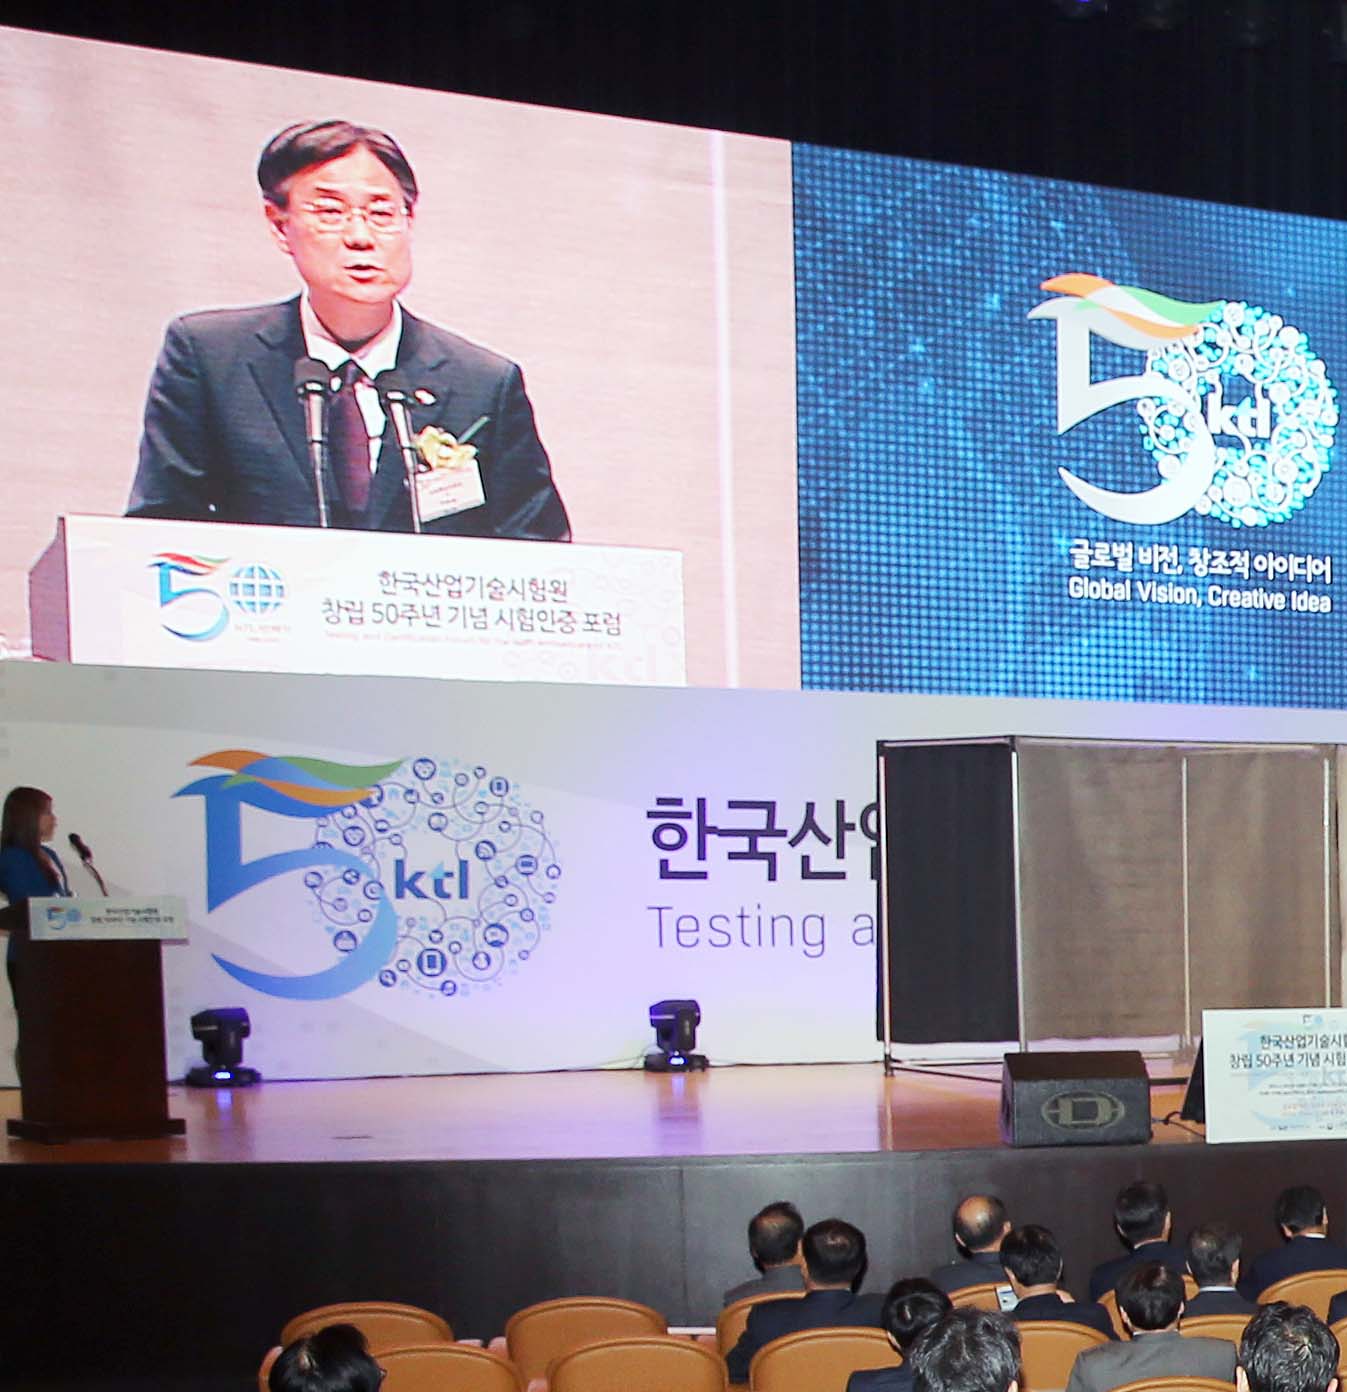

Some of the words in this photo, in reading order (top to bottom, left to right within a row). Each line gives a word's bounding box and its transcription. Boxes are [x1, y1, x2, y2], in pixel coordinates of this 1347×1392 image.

[1069, 538, 1134, 572] 글로벌
[1188, 547, 1250, 580] 창조적
[1253, 552, 1332, 585] 아이디어
[378, 569, 568, 604] 한국산업기술시험원
[1068, 576, 1132, 601] Global
[1136, 579, 1202, 608] Vision,
[1207, 585, 1286, 611] Creative
[1291, 590, 1332, 613] Idea
[322, 597, 365, 626] 창립
[371, 602, 442, 629] 50주년
[447, 604, 488, 631] 기념
[495, 607, 577, 635] 시험인증
[582, 611, 622, 637] 포럼
[394, 859, 470, 901] ktl
[646, 903, 826, 959] Testing
